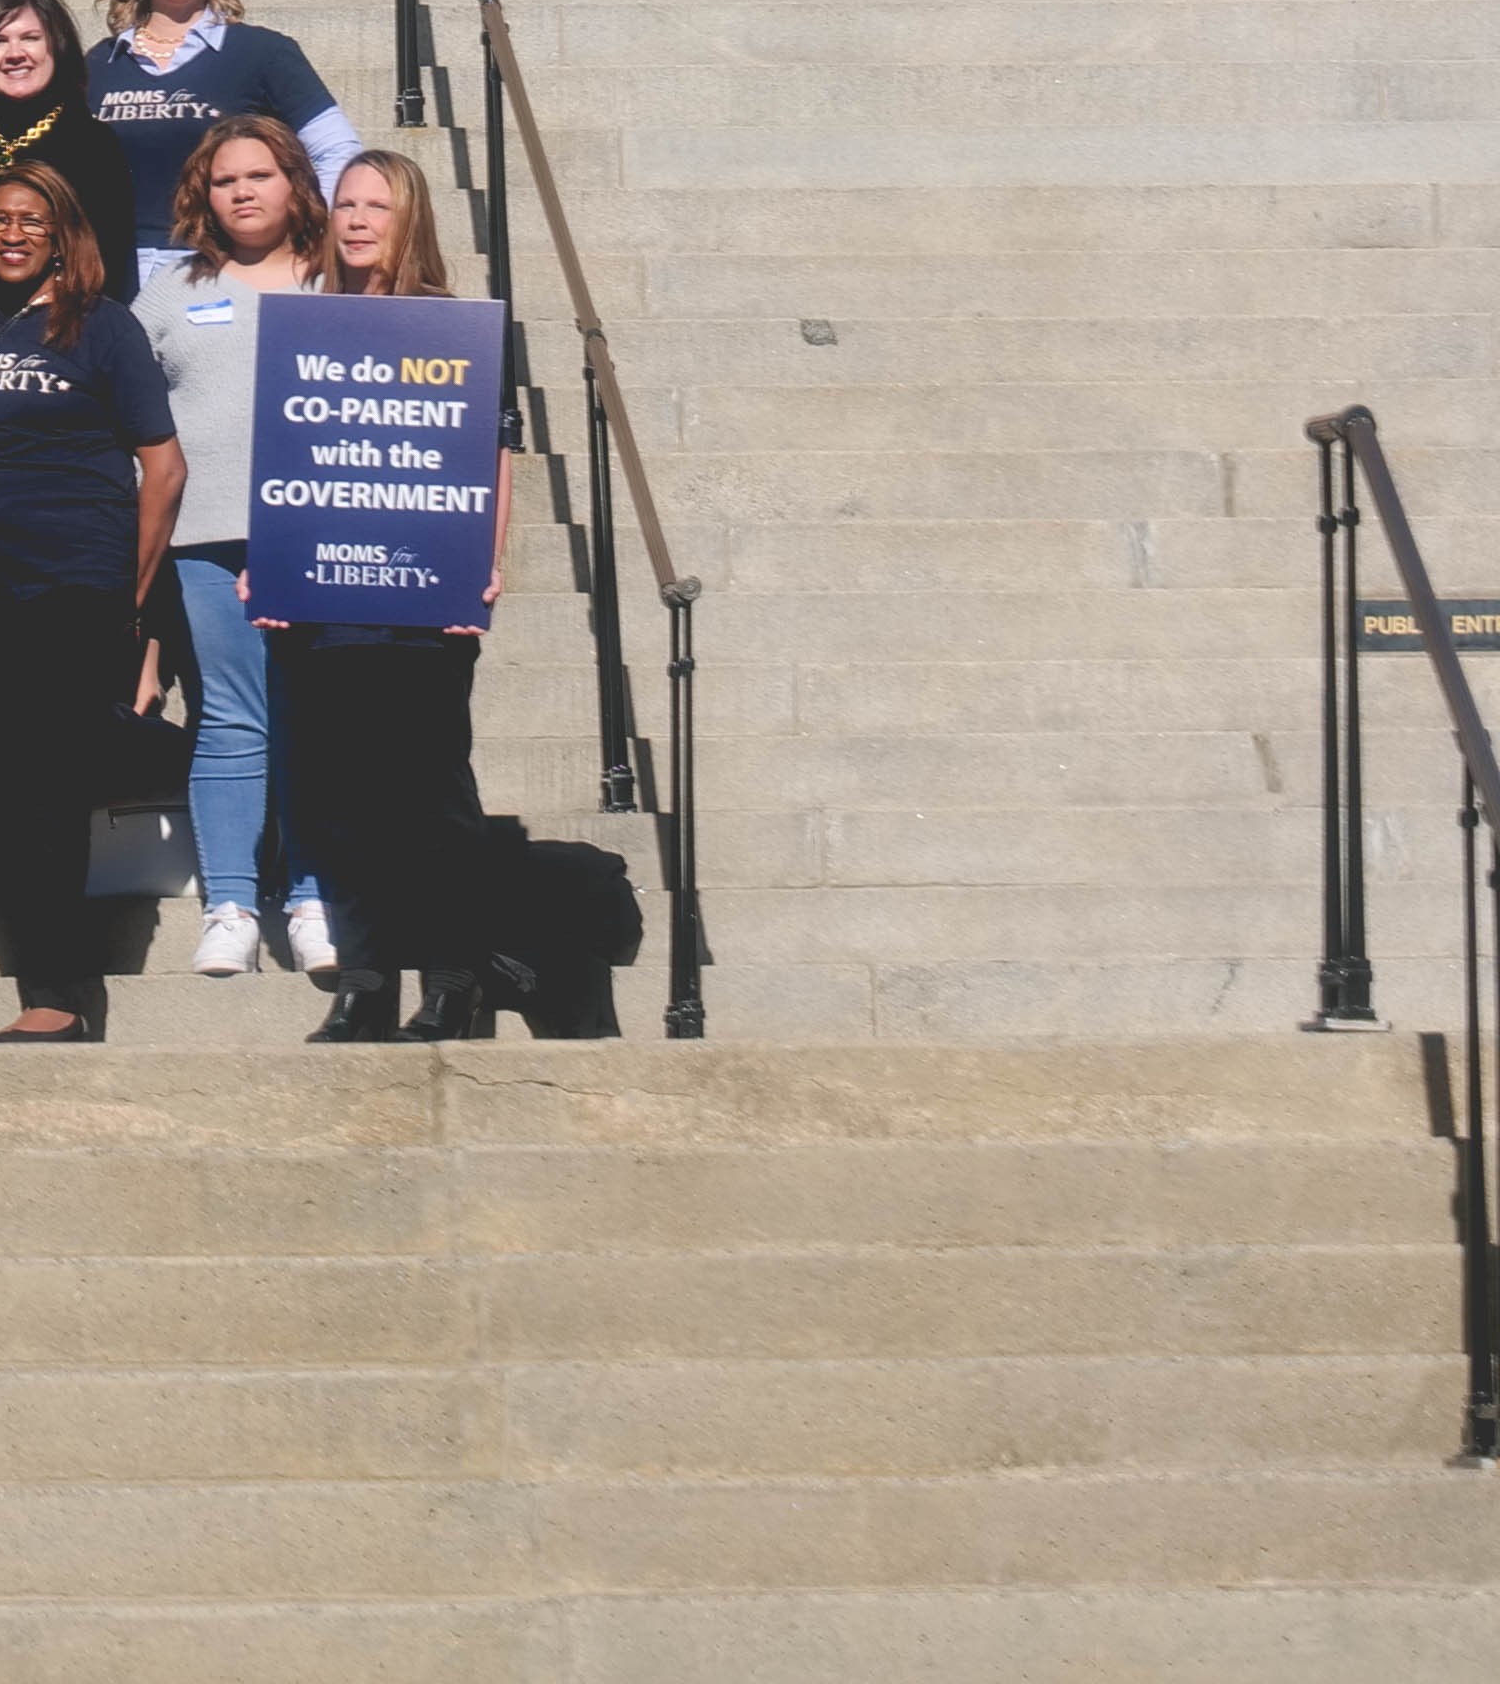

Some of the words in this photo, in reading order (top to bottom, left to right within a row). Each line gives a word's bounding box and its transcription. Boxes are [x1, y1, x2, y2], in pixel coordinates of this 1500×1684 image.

[102, 90, 166, 106] MOMS
[166, 88, 196, 104] for
[99, 102, 209, 121] LIBERTY
[13, 354, 48, 371] for
[296, 354, 346, 382] We
[351, 355, 394, 383] do
[401, 358, 471, 386] NOT
[283, 396, 468, 428] CO-PARENT
[311, 440, 382, 468] with
[388, 441, 443, 470] the
[260, 479, 492, 513] GOVERNMENT
[316, 543, 388, 564] MOMS
[388, 545, 419, 568] for
[316, 564, 433, 588] LIBERTY
[1364, 616, 1424, 635] PUBL
